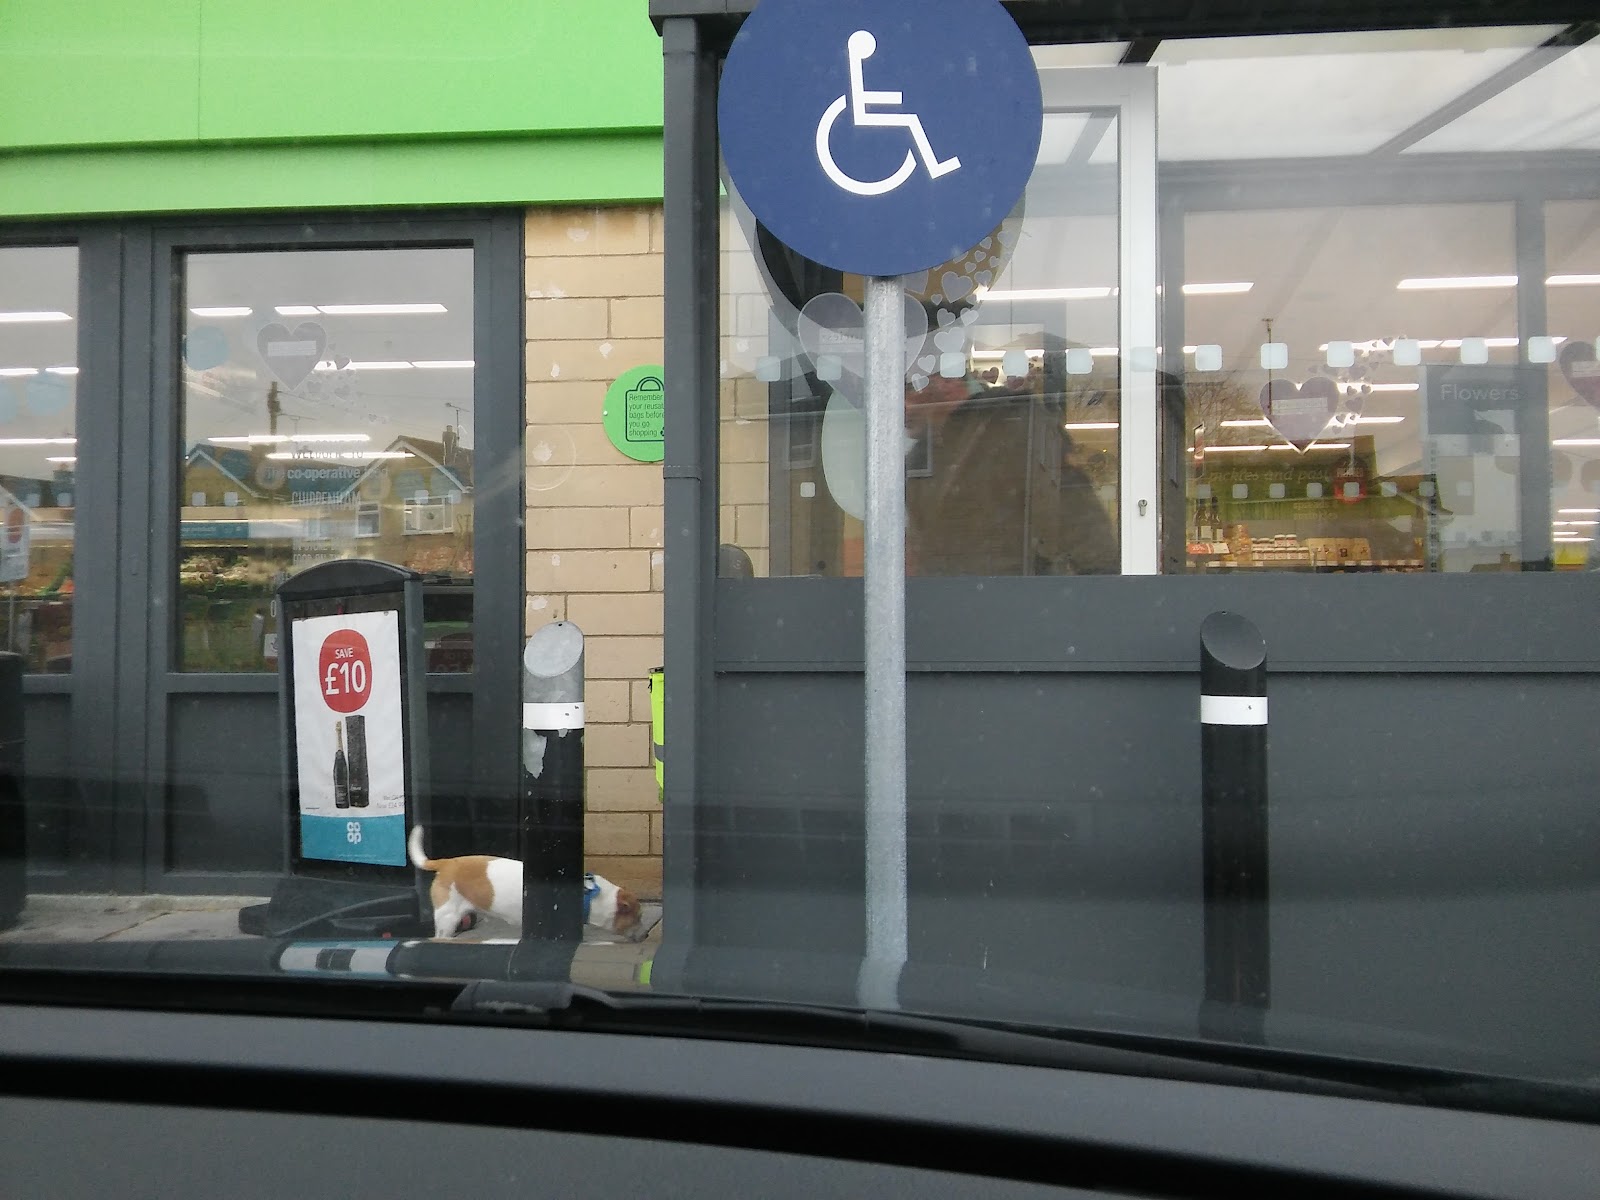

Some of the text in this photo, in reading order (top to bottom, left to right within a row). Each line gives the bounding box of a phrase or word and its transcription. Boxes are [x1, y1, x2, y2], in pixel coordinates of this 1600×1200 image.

[1440, 384, 1520, 400] Flowers
[629, 403, 643, 411] your
[629, 411, 644, 419] bags
[629, 421, 640, 429] you
[287, 467, 361, 481] co-operative
[335, 648, 354, 659] SAVE
[325, 660, 366, 695] £10
